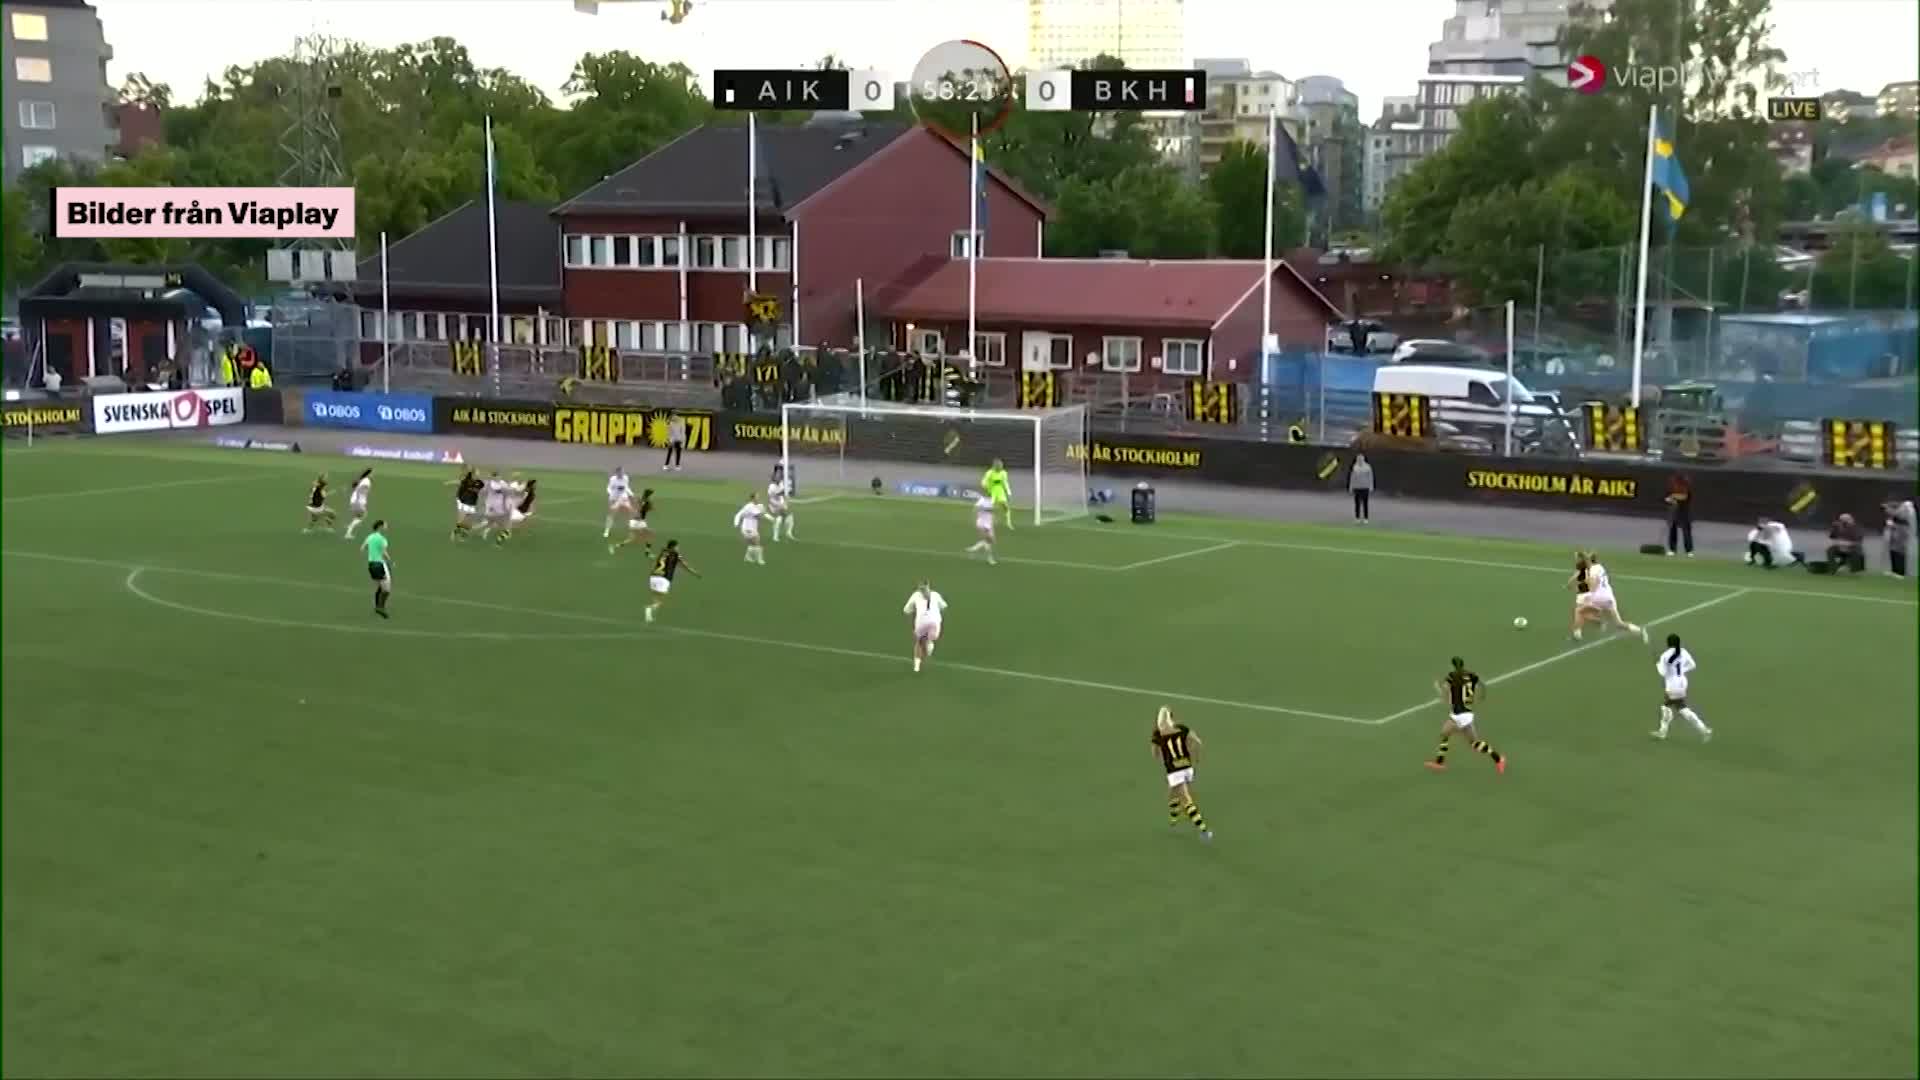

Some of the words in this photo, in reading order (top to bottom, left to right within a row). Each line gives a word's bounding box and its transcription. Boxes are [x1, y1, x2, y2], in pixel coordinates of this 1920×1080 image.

[4, 408, 81, 427] STOCKHOLM!
[103, 400, 170, 423] SVENSKA
[205, 398, 237, 415] SPEL
[453, 408, 470, 422] AIK
[554, 409, 644, 447] GRUPP
[734, 423, 801, 441] STOCKHOM
[1114, 447, 1201, 466] STOCKHOLM!
[1467, 471, 1566, 493] STOCKHOLM
[1569, 474, 1594, 494] ÄR
[1597, 480, 1637, 497] AIK!
[1166, 735, 1185, 759] 11
